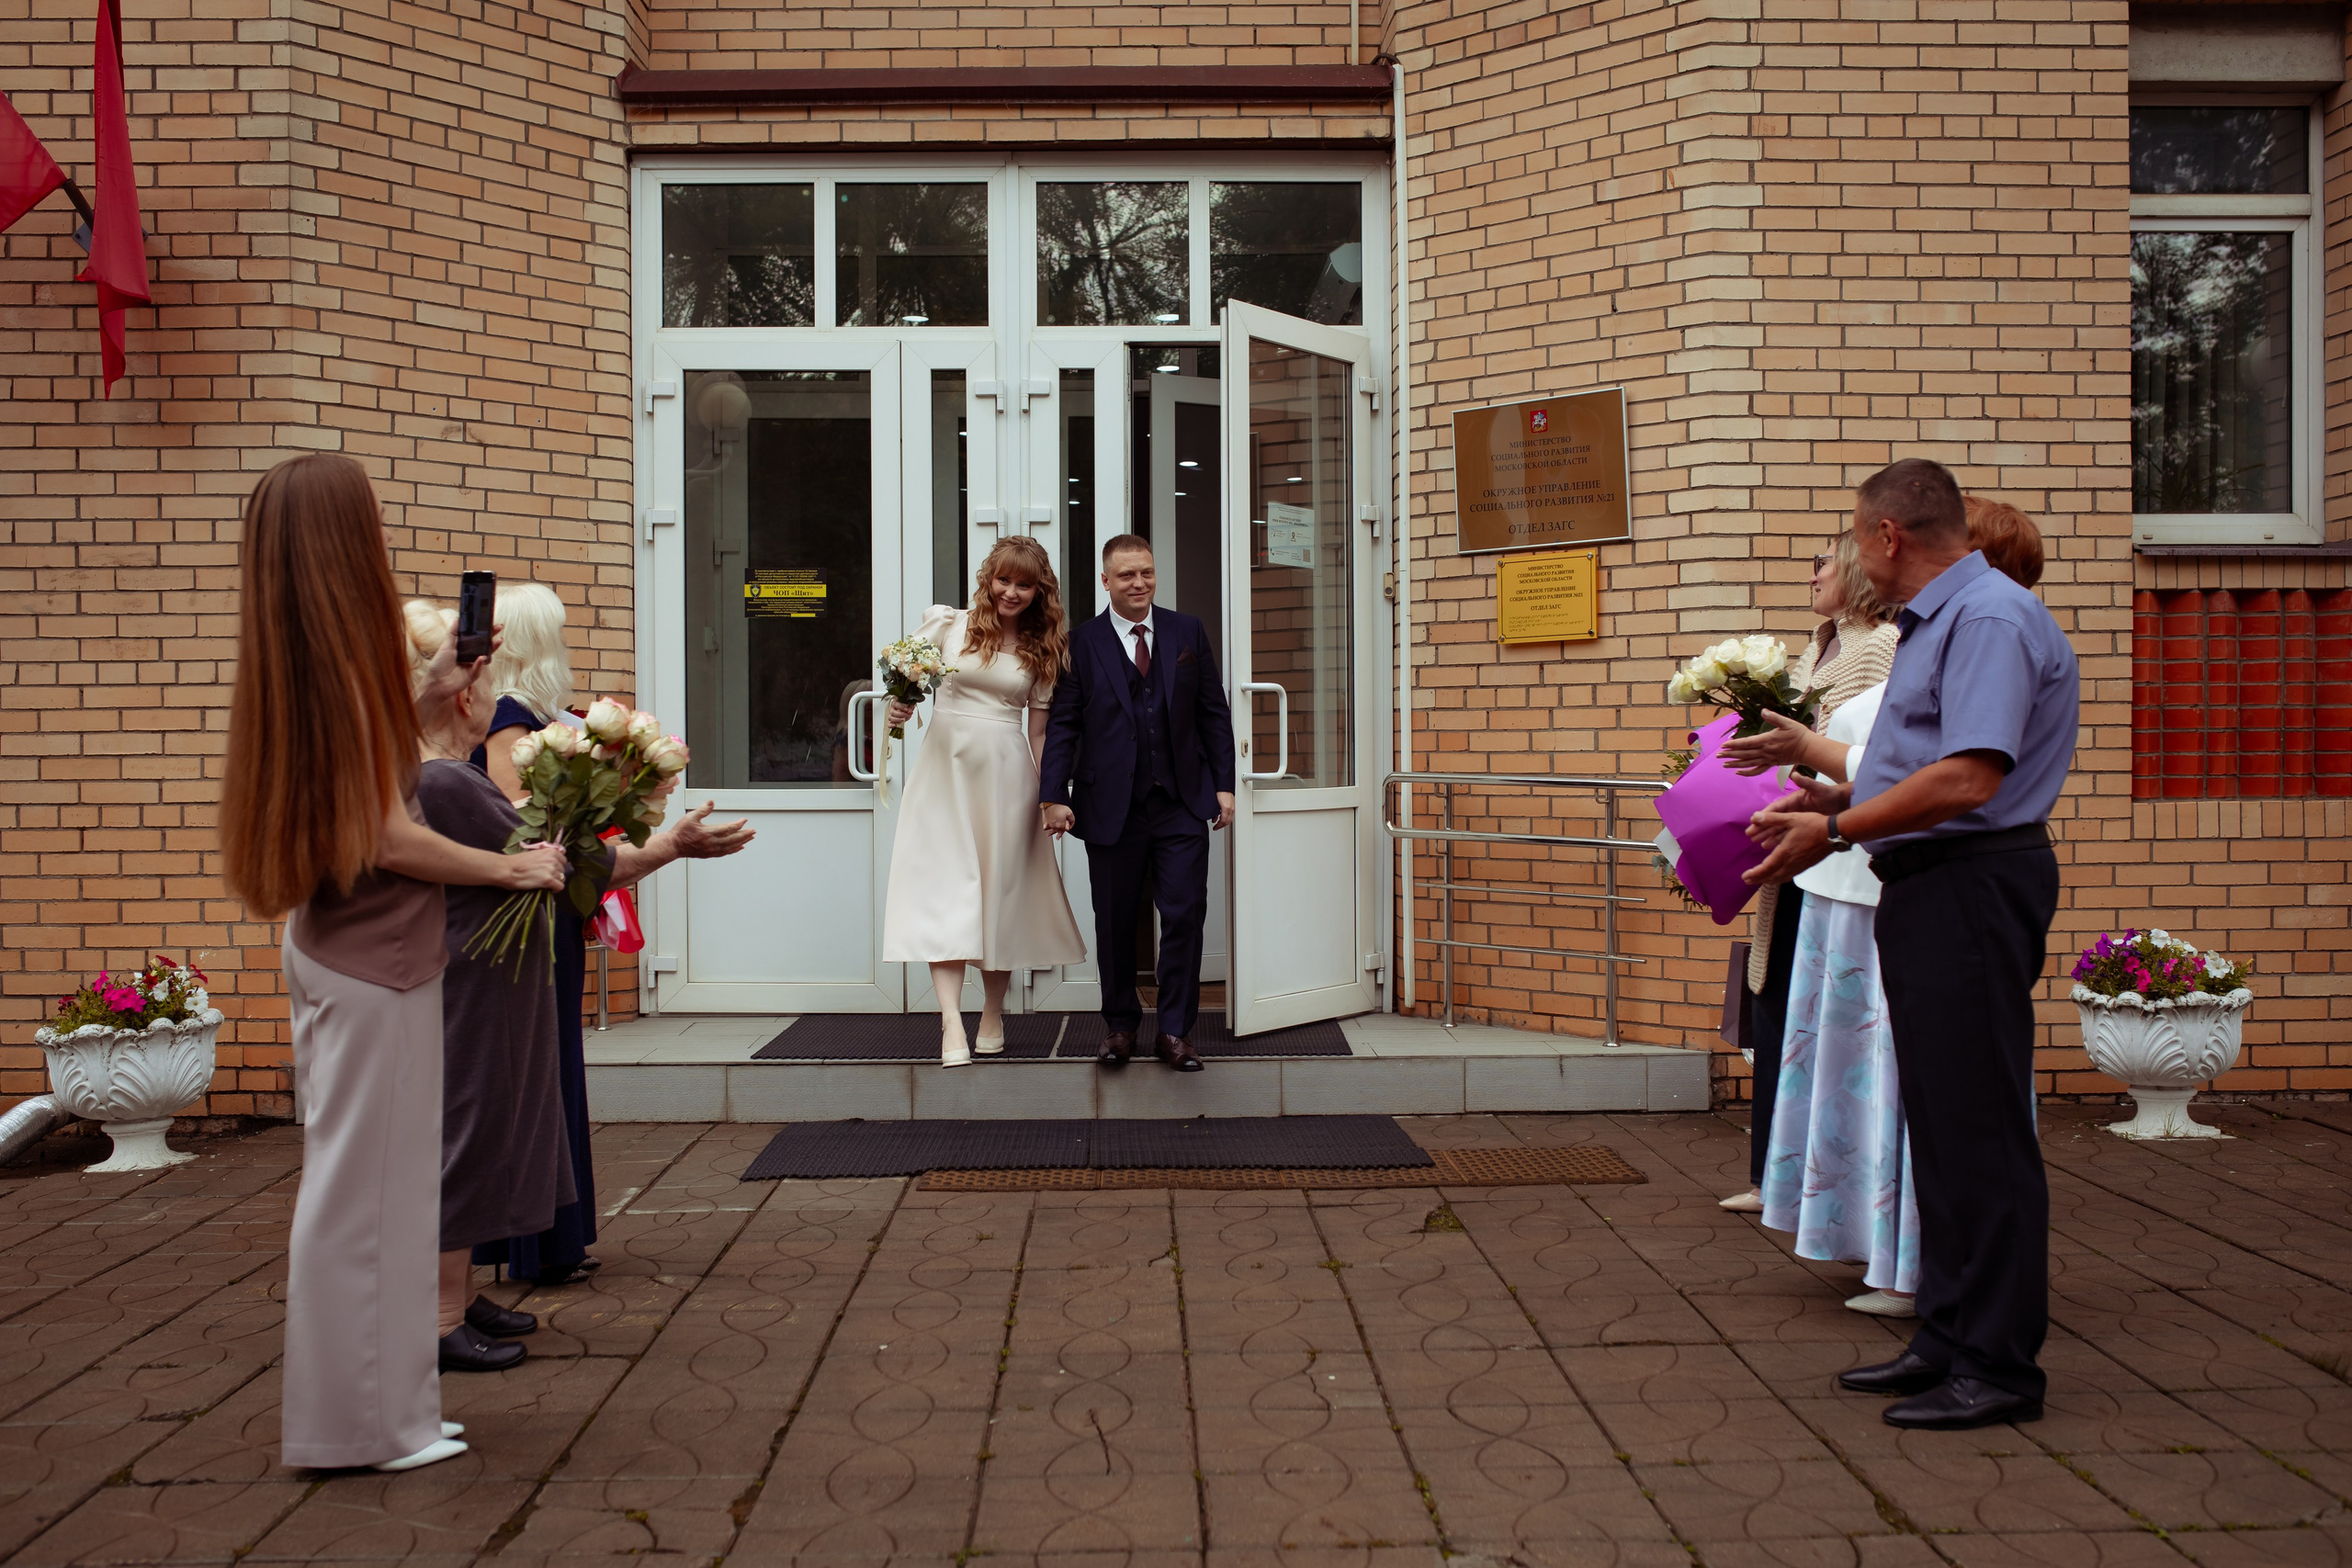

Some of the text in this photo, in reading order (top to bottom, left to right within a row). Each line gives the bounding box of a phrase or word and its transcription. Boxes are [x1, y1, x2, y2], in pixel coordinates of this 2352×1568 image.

[1509, 436, 1571, 448] МИНИСТЕРСТВО
[1491, 445, 1590, 461] СОЦИАЛЬНОГО РАЗВИТИЯ
[1495, 457, 1587, 472] МОСКОВСКОЙ ОБЛАСТИ
[1483, 480, 1600, 498] ОКРУЖНОЕ УПРАВЛЕНИЕ
[1470, 493, 1615, 512] СОЦИАЛЬНОГО РАЗВИТИЯ №21
[1508, 520, 1575, 535] ОТДЕЛ ЗАГС
